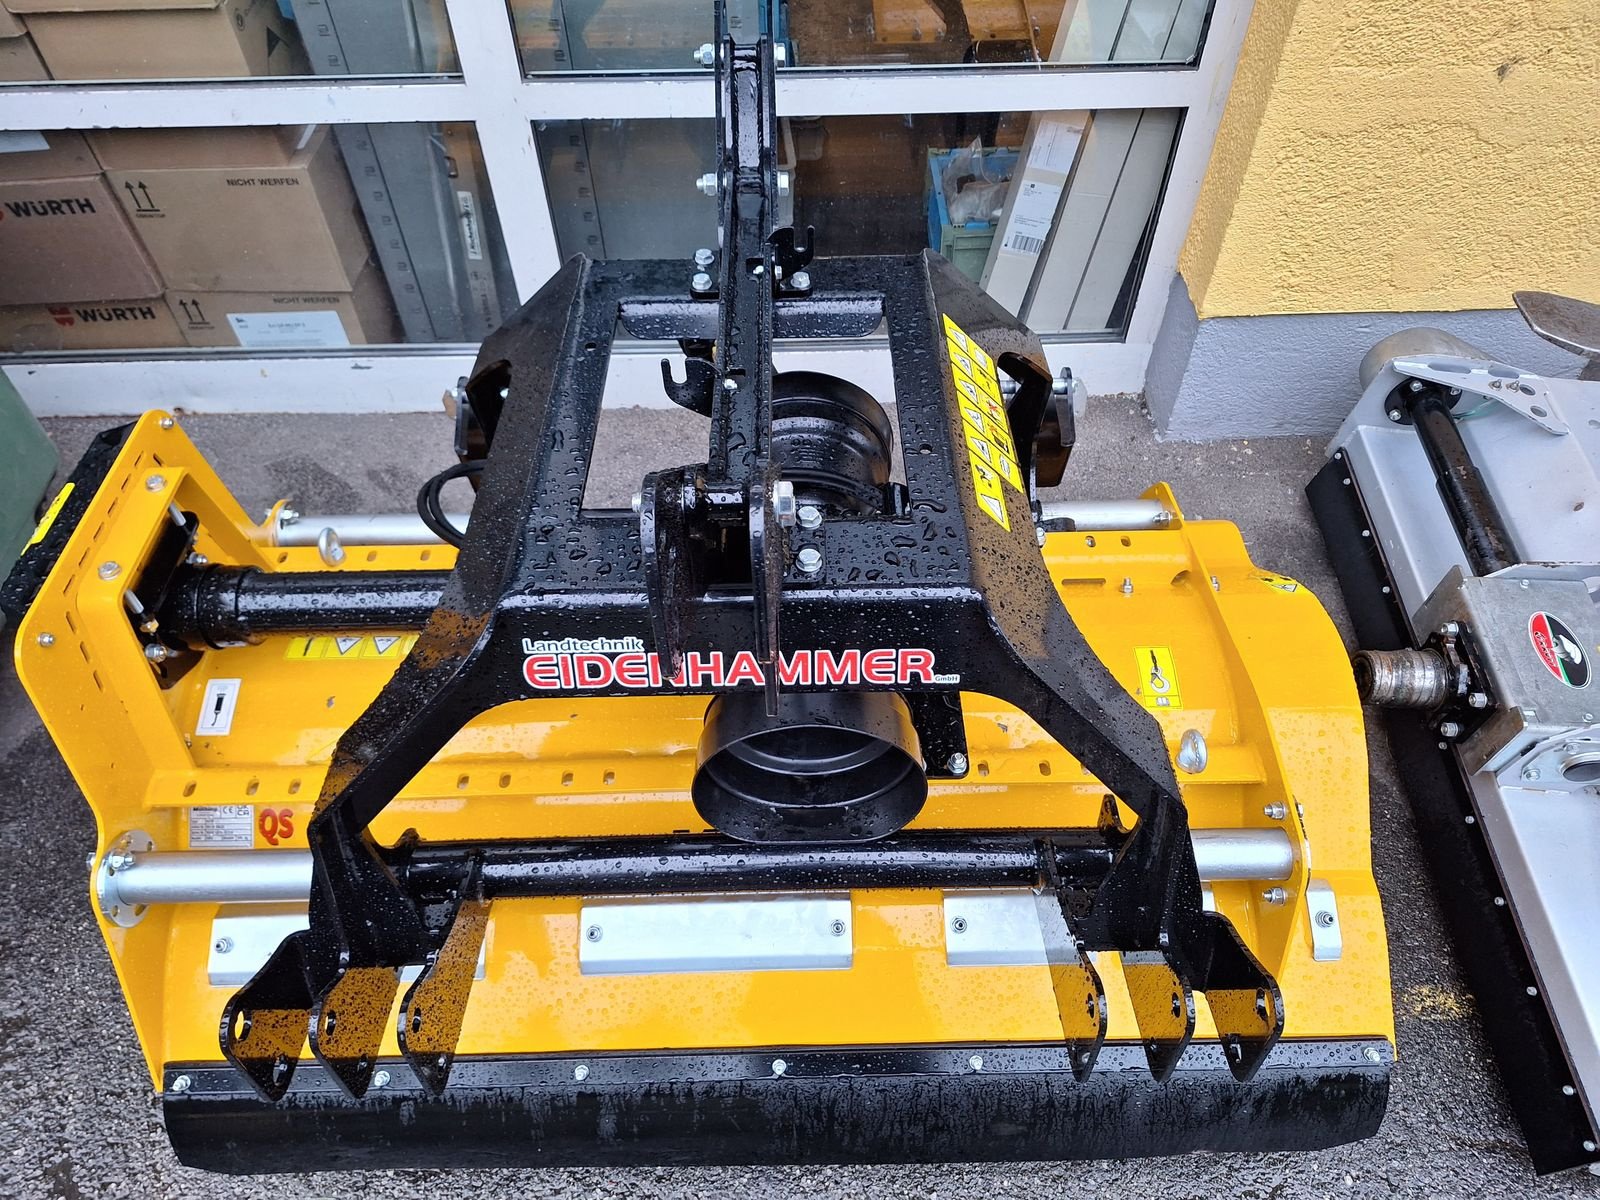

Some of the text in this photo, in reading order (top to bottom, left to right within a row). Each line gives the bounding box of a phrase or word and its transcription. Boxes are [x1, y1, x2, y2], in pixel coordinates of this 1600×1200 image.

[226, 177, 300, 186] NICHT WERFEN
[4, 198, 97, 218] WÜRTH
[74, 306, 157, 323] WÜRTH
[523, 637, 645, 653] Landtechnik
[934, 674, 959, 683] GmbH
[258, 808, 294, 846] QS
